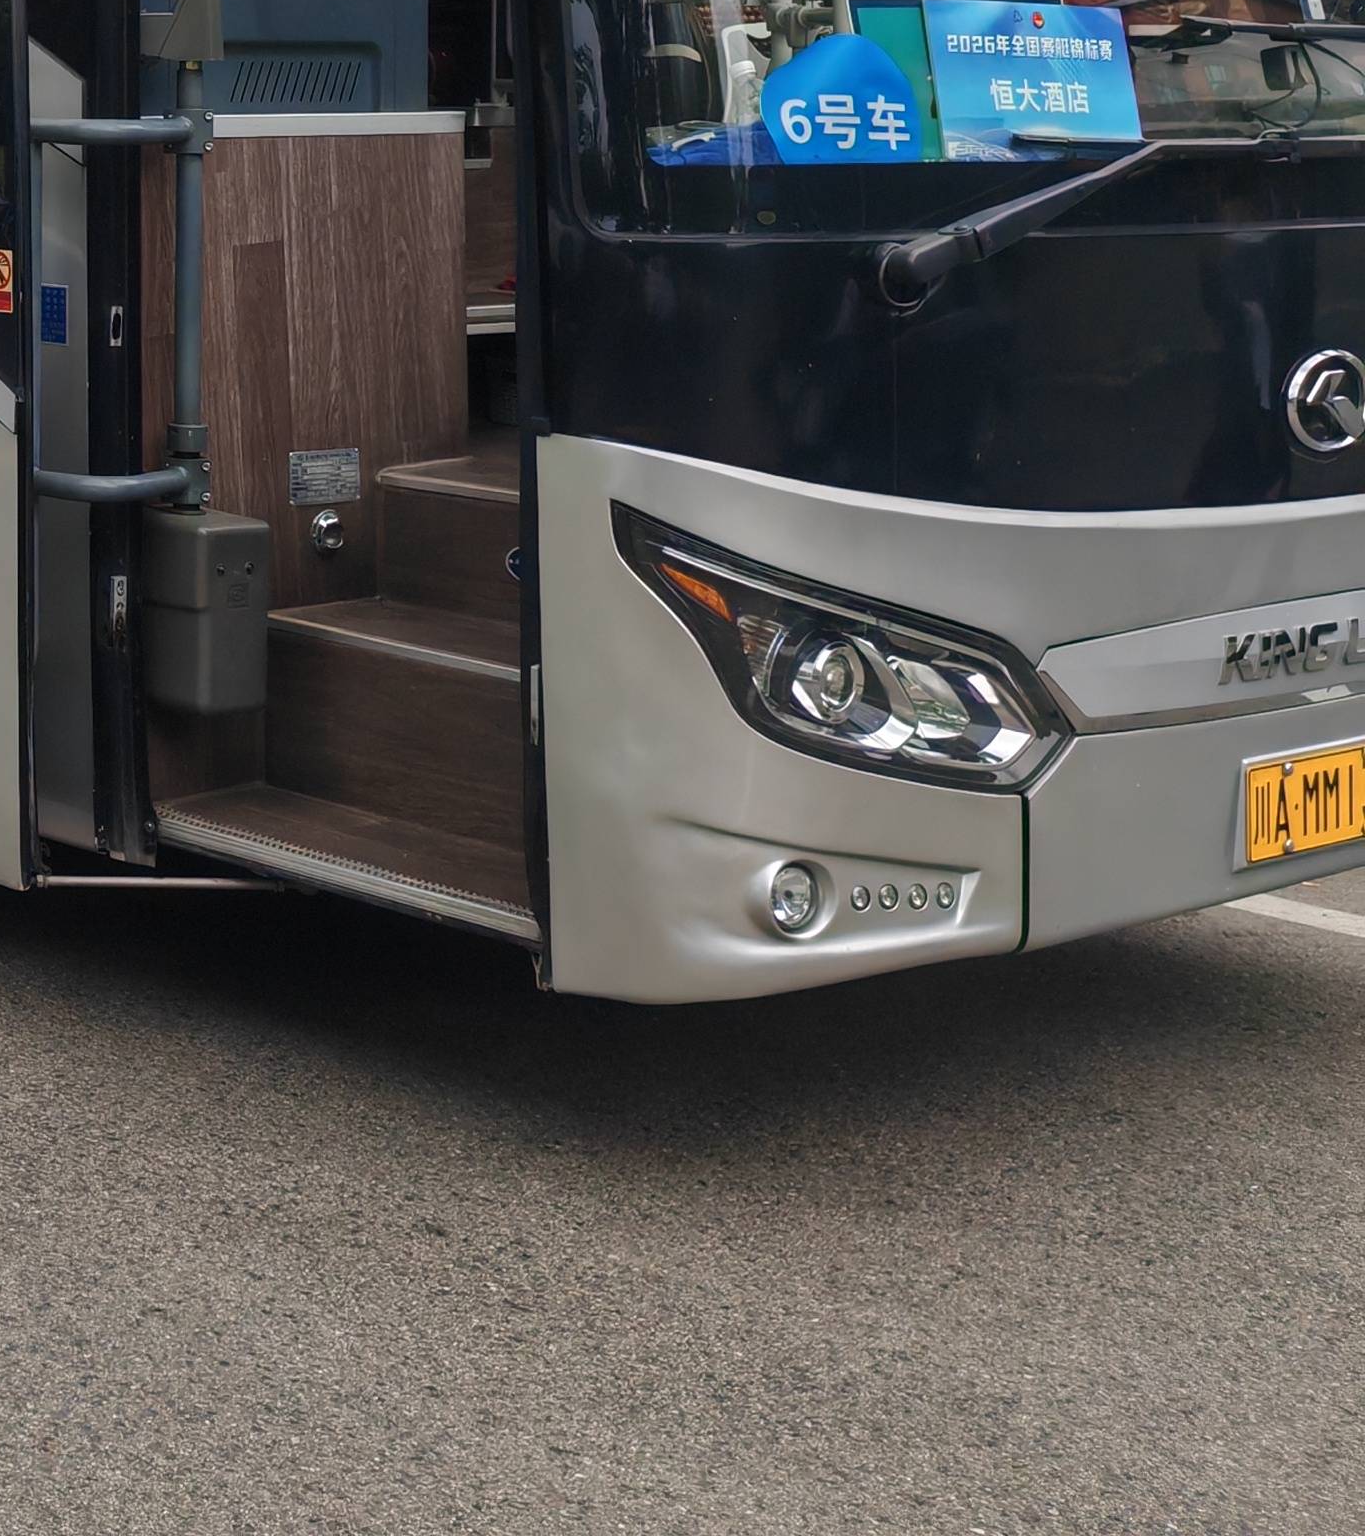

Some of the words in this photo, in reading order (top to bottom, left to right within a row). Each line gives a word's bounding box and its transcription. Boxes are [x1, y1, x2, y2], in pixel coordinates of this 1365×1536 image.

[947, 34, 1113, 61] 2026年全国赛艇锦标赛
[989, 77, 1090, 114] 恒大酒店
[779, 93, 911, 151] 6号车
[1218, 620, 1338, 686] KING
